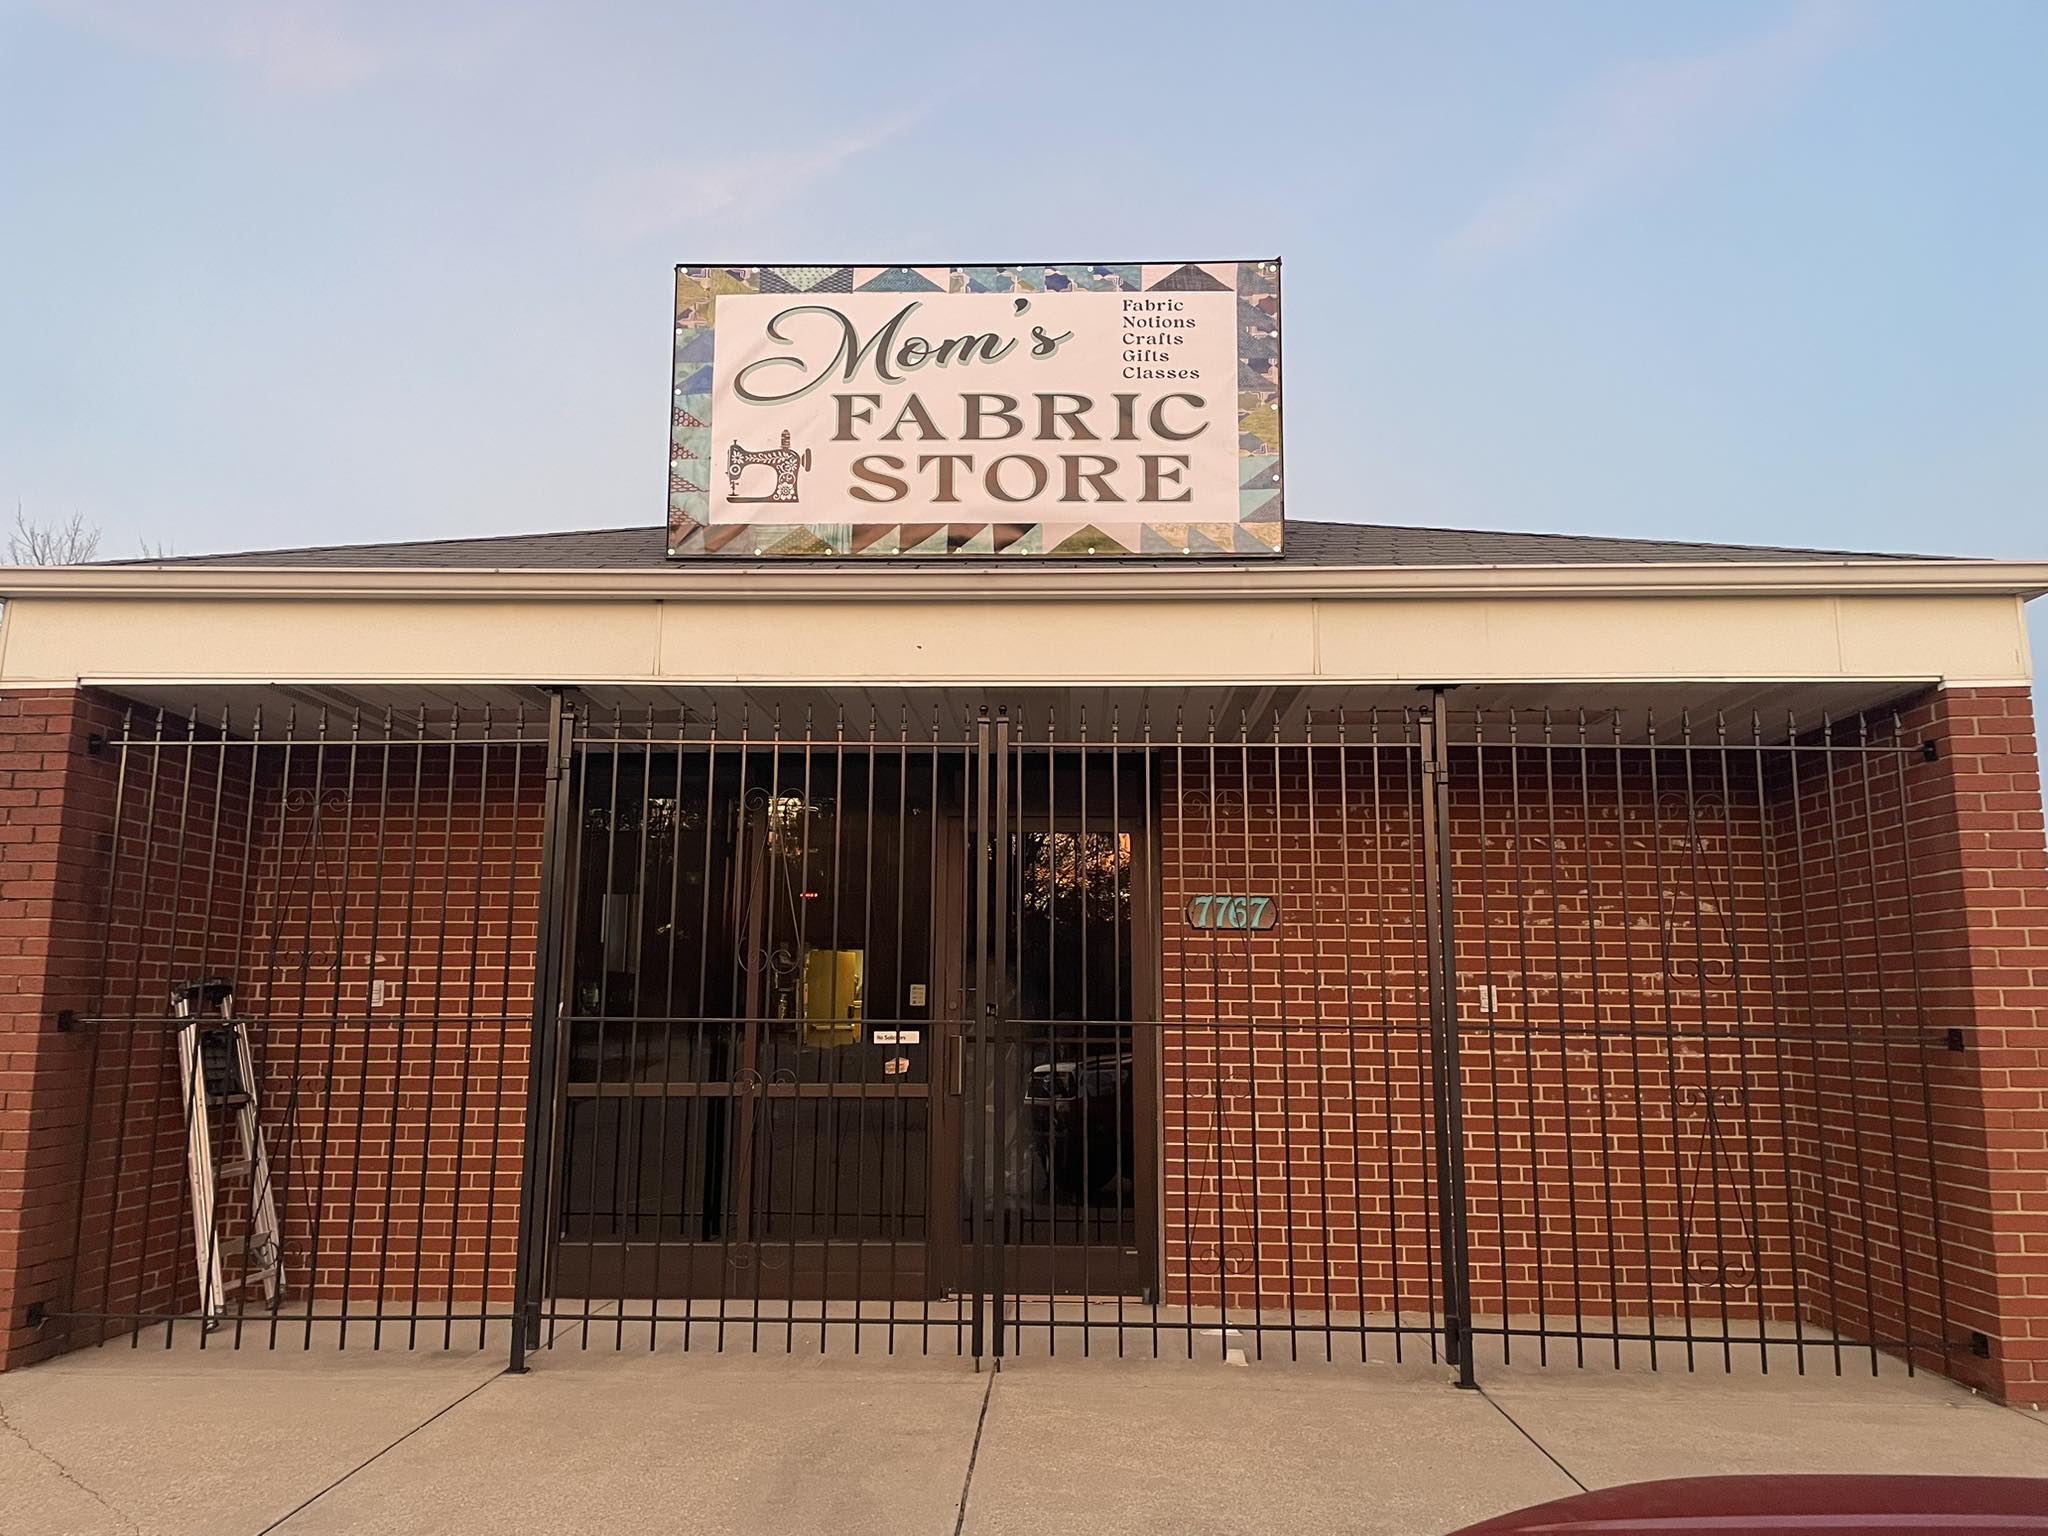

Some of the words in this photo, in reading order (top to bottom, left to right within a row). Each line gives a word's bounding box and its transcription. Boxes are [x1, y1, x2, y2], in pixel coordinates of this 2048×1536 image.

[1122, 299, 1184, 312] Fabric
[1122, 315, 1196, 328] Notions
[1122, 332, 1184, 345] Crafts
[734, 298, 1074, 406] Mom's
[1122, 349, 1170, 362] Gifts
[1122, 366, 1200, 379] Classes
[830, 392, 1211, 442] FABRIC
[847, 453, 1195, 503] STORE
[1195, 895, 1270, 928] 7767
